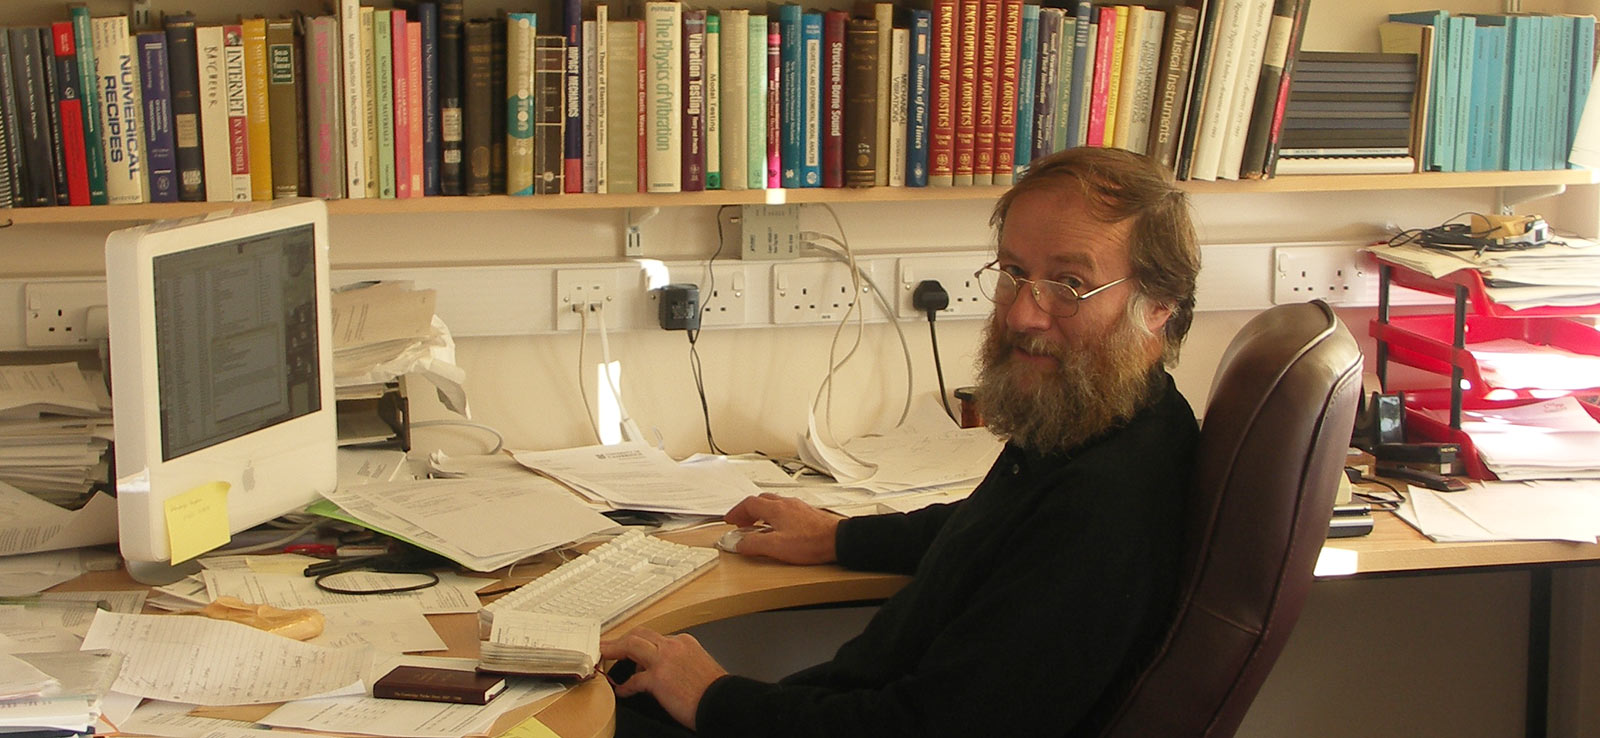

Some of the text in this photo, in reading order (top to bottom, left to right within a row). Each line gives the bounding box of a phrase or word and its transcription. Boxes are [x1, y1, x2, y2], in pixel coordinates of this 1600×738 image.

[227, 50, 245, 114] INTERNET
[567, 46, 579, 117] IMPACT MECHANICS
[599, 76, 605, 84] of
[652, 16, 673, 151] The Physics of Vibration
[688, 33, 702, 77] Vibration
[830, 42, 842, 136] Structure-Borne Sound
[937, 6, 953, 127] ENCYCLOPEDIA OF ACOUSTICS
[960, 4, 977, 125] ENCYCLOPEDIA OF ACOUSTICS
[980, 3, 997, 124] ENCYCLOPEDIA OF ACOUSTICS
[1002, 4, 1018, 124] ENCYCLOPEDIA OF ACOUSTICS
[1137, 42, 1157, 123] FUNDAMENTALS OF
[1158, 28, 1186, 143] Musical Instruments
[104, 76, 122, 162] RECIPES
[120, 55, 140, 180] NUMERICAL
[234, 118, 242, 127] IN
[598, 86, 606, 117] Elasticity
[686, 80, 702, 115] Testing
[891, 76, 899, 123] VIBRATIONS
[898, 73, 907, 126] MECHANICAL
[914, 63, 926, 149] Sounds of Our Times
[234, 138, 244, 172] NUTSHELL
